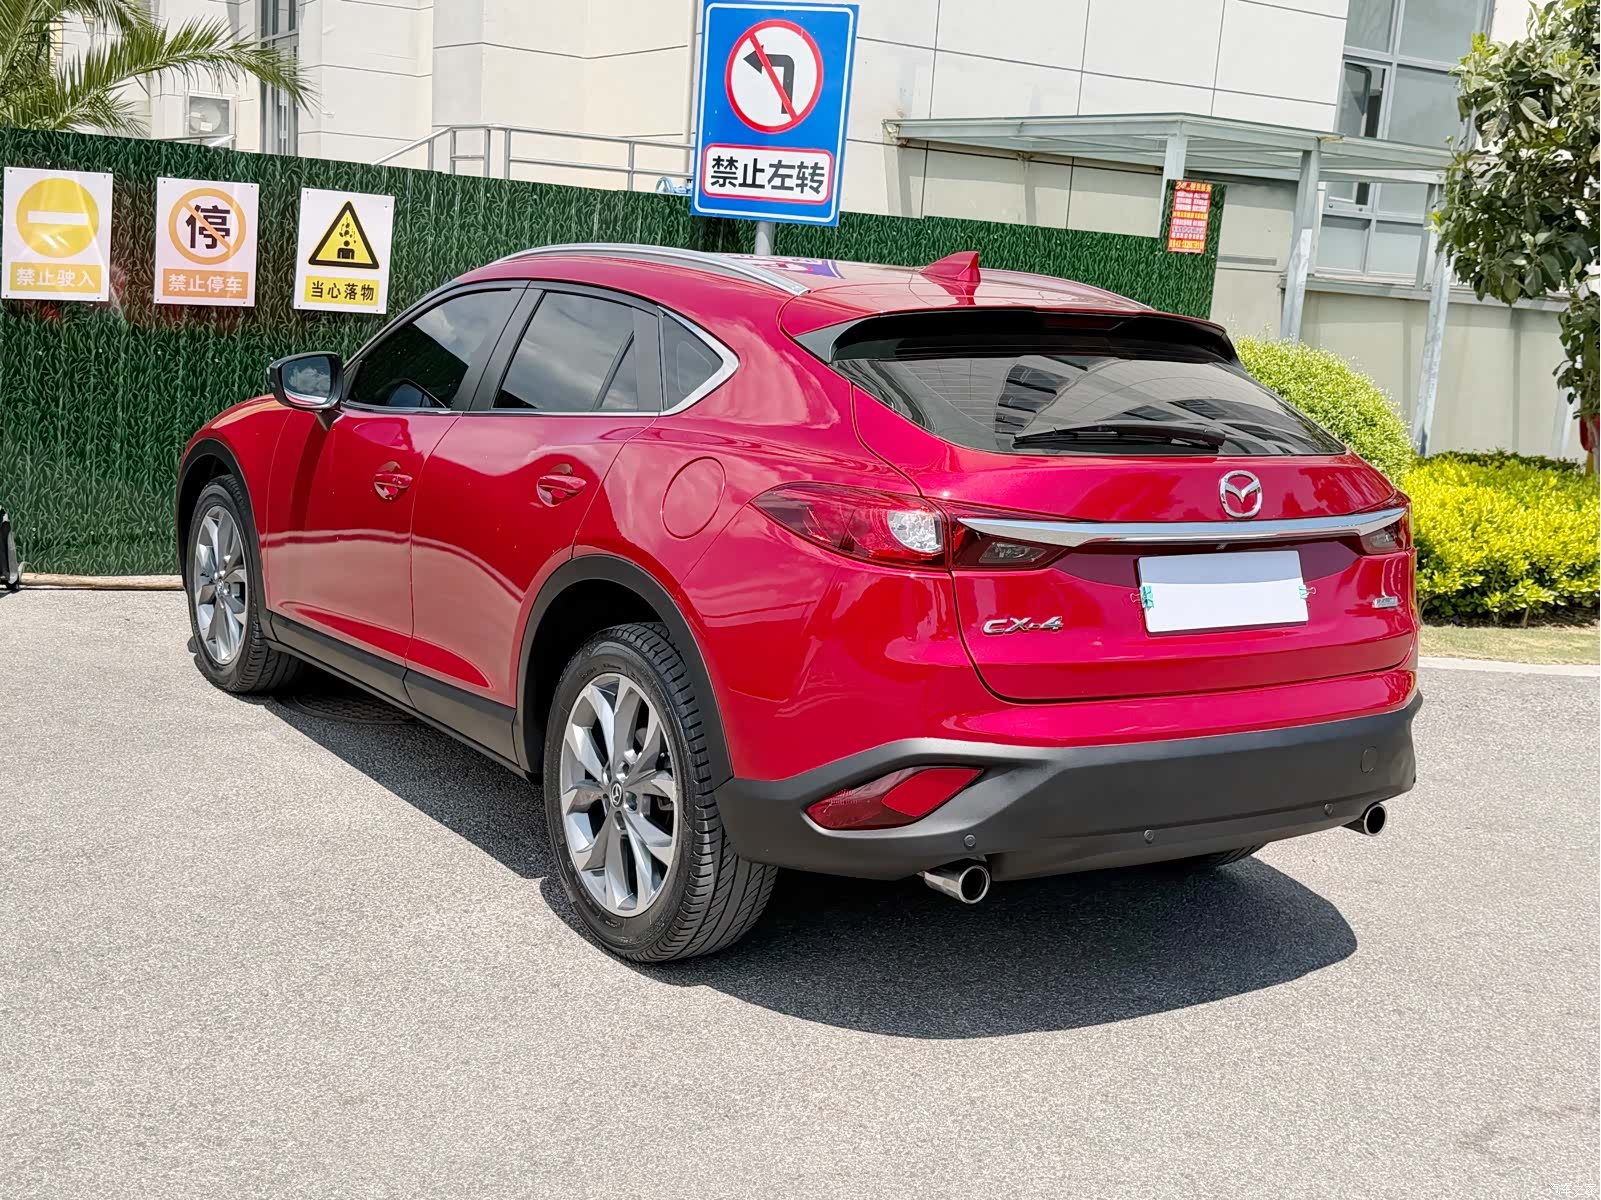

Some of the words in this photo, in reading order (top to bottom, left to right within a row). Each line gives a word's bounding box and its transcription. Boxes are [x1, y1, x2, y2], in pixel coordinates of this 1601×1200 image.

[710, 155, 825, 195] 禁止左转
[186, 203, 231, 249] 停
[15, 267, 97, 289] 禁止驶入
[167, 273, 243, 295] 禁止停车
[310, 279, 376, 303] 当心落物
[983, 616, 1063, 634] CX-4
